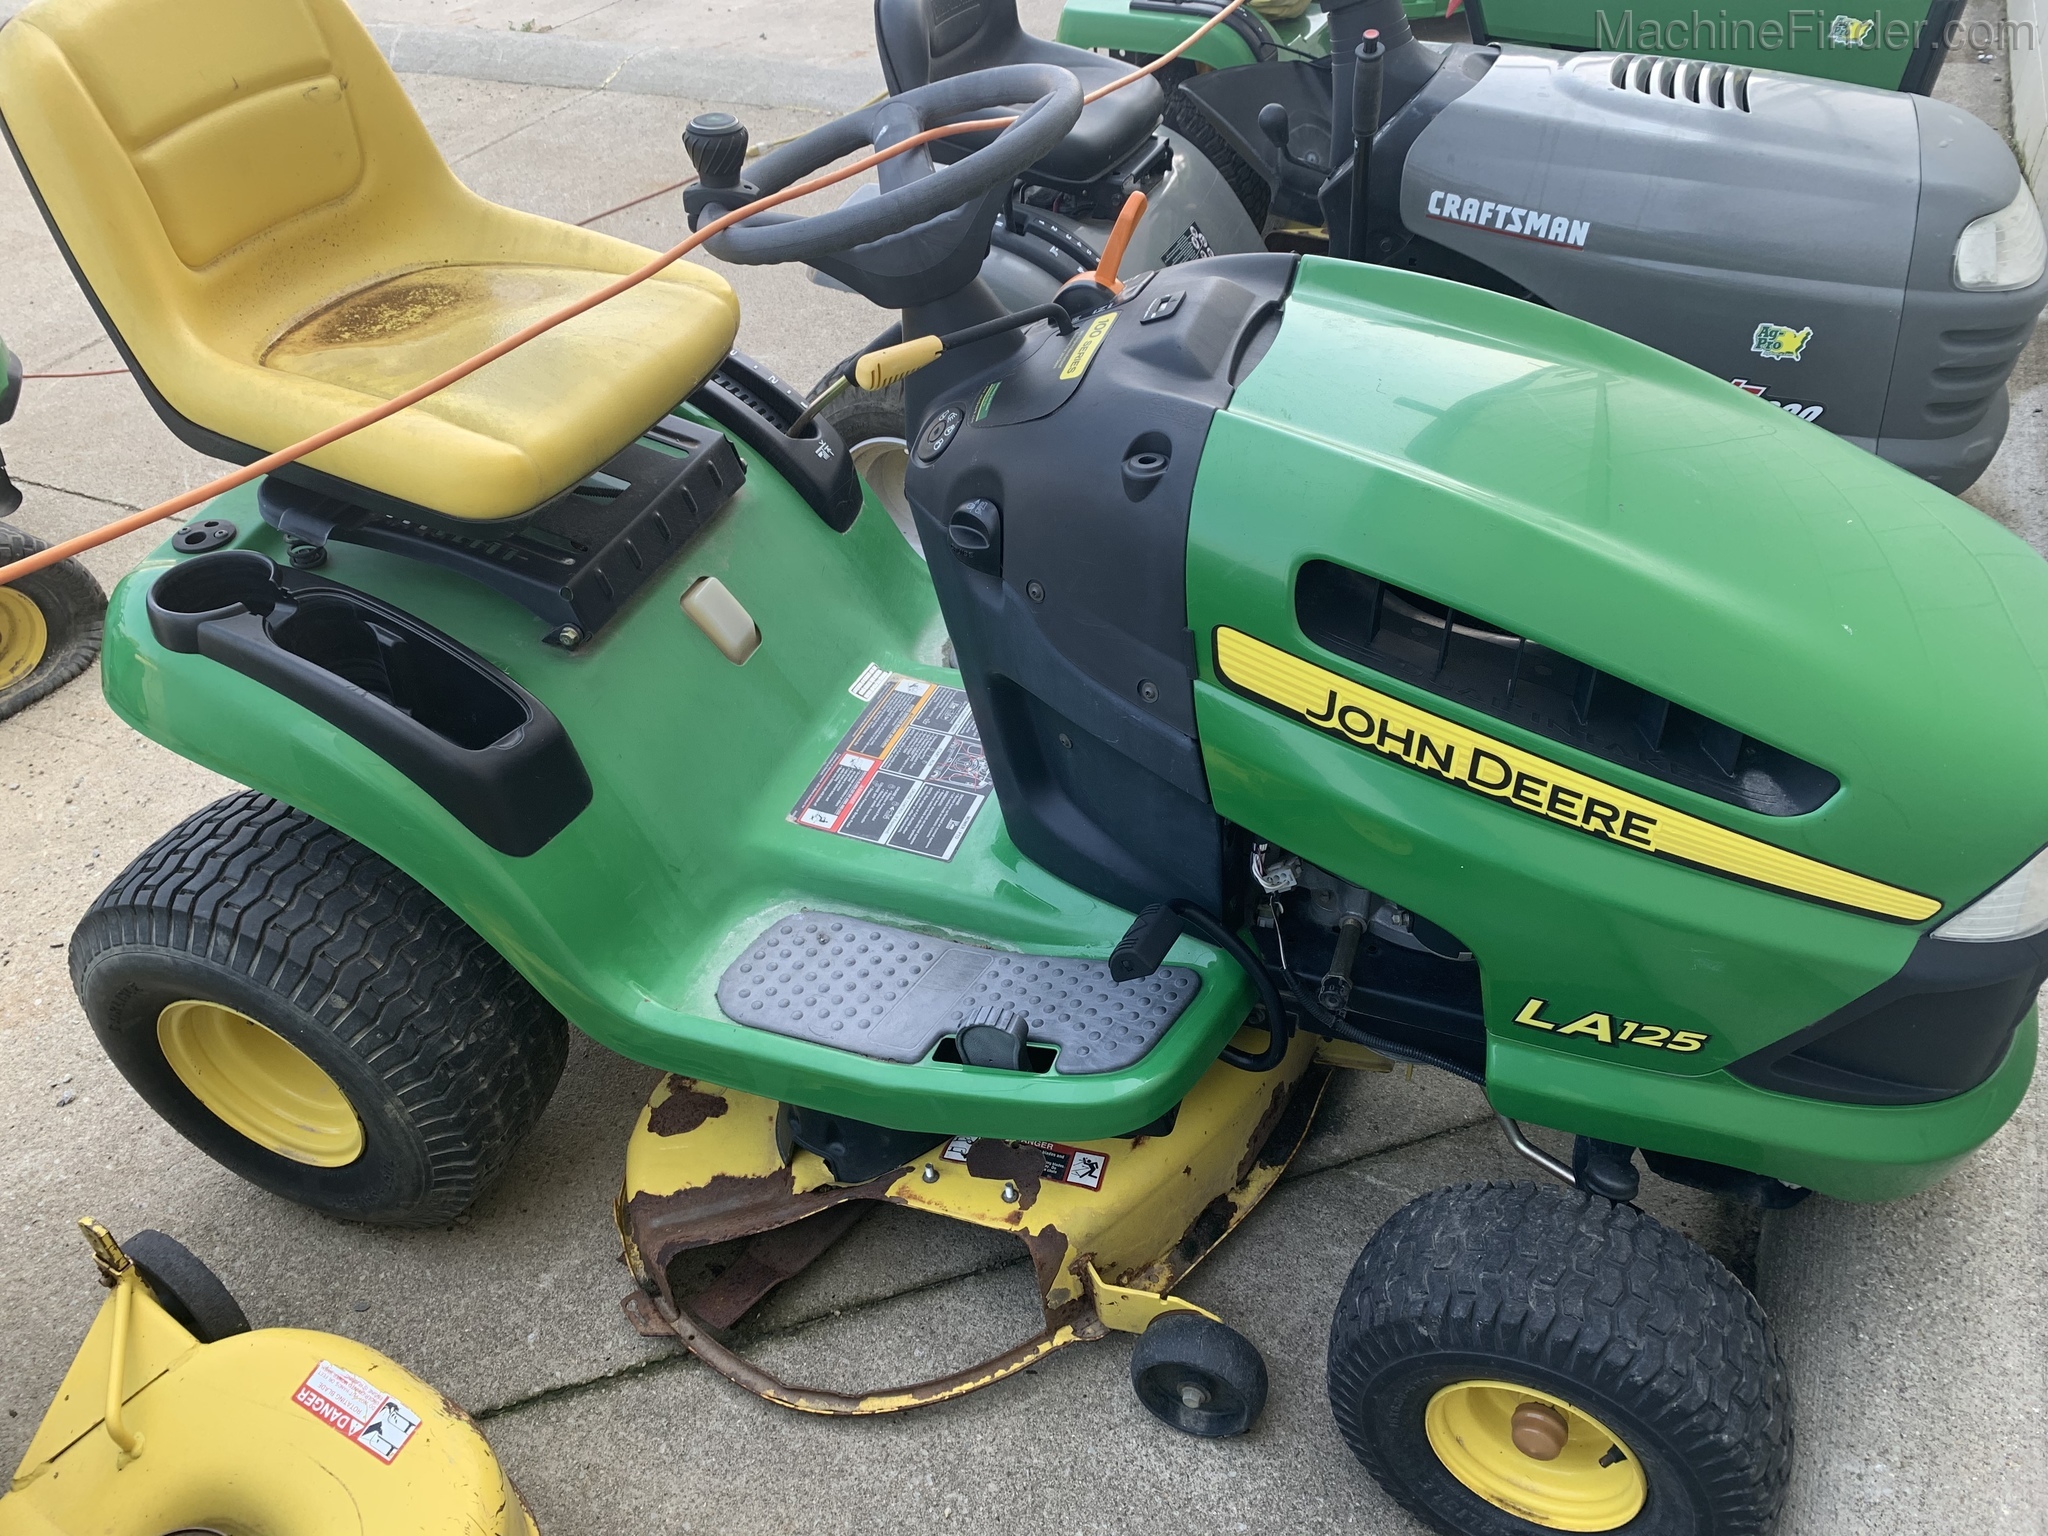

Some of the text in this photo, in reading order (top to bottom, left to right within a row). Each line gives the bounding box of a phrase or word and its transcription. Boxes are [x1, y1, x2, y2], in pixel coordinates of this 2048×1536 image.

[1427, 190, 1591, 247] CRAFTSMAN
[1091, 318, 1110, 339] 100
[1755, 337, 1783, 350] Pro
[1757, 326, 1785, 340] Ag-
[1065, 339, 1093, 375] SERIES
[1305, 690, 1658, 846] JOHN DEERE
[1513, 997, 1709, 1053] LA125
[294, 1385, 351, 1429] DANGER
[316, 1381, 362, 1415] ROTATING BLADE
